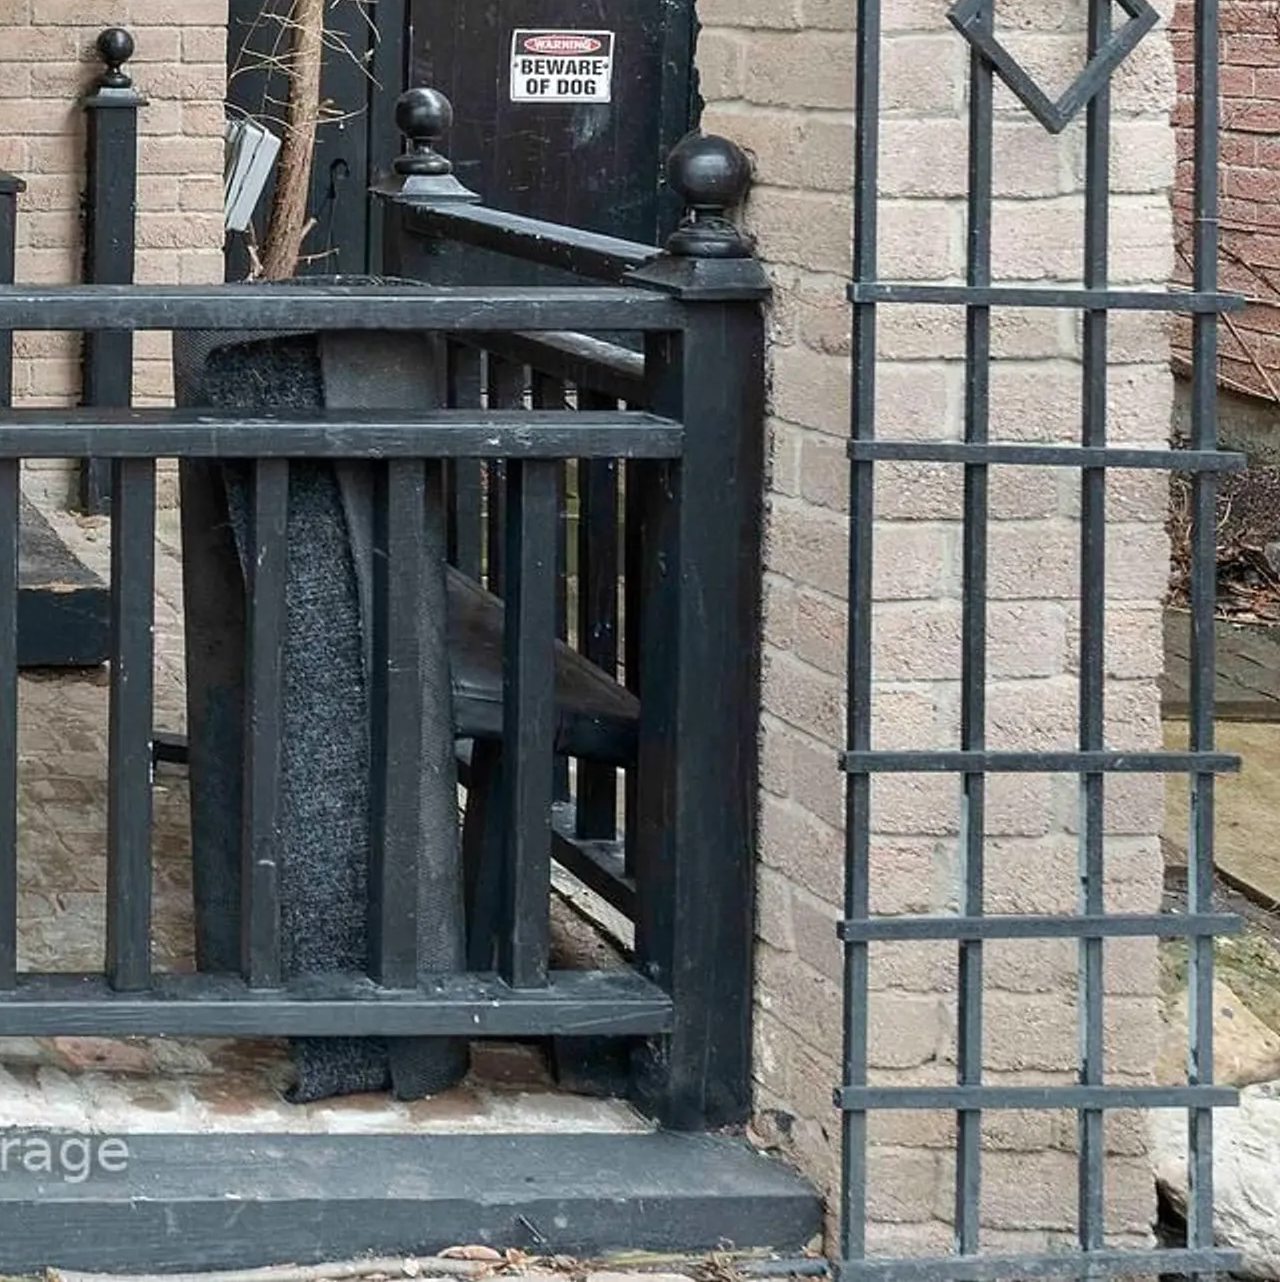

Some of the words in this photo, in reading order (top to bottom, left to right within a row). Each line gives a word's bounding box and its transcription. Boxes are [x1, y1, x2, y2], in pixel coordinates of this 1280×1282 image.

[535, 39, 590, 50] WARNING
[521, 59, 603, 75] BEWARE
[526, 78, 550, 95] OF
[557, 79, 596, 95] DOG
